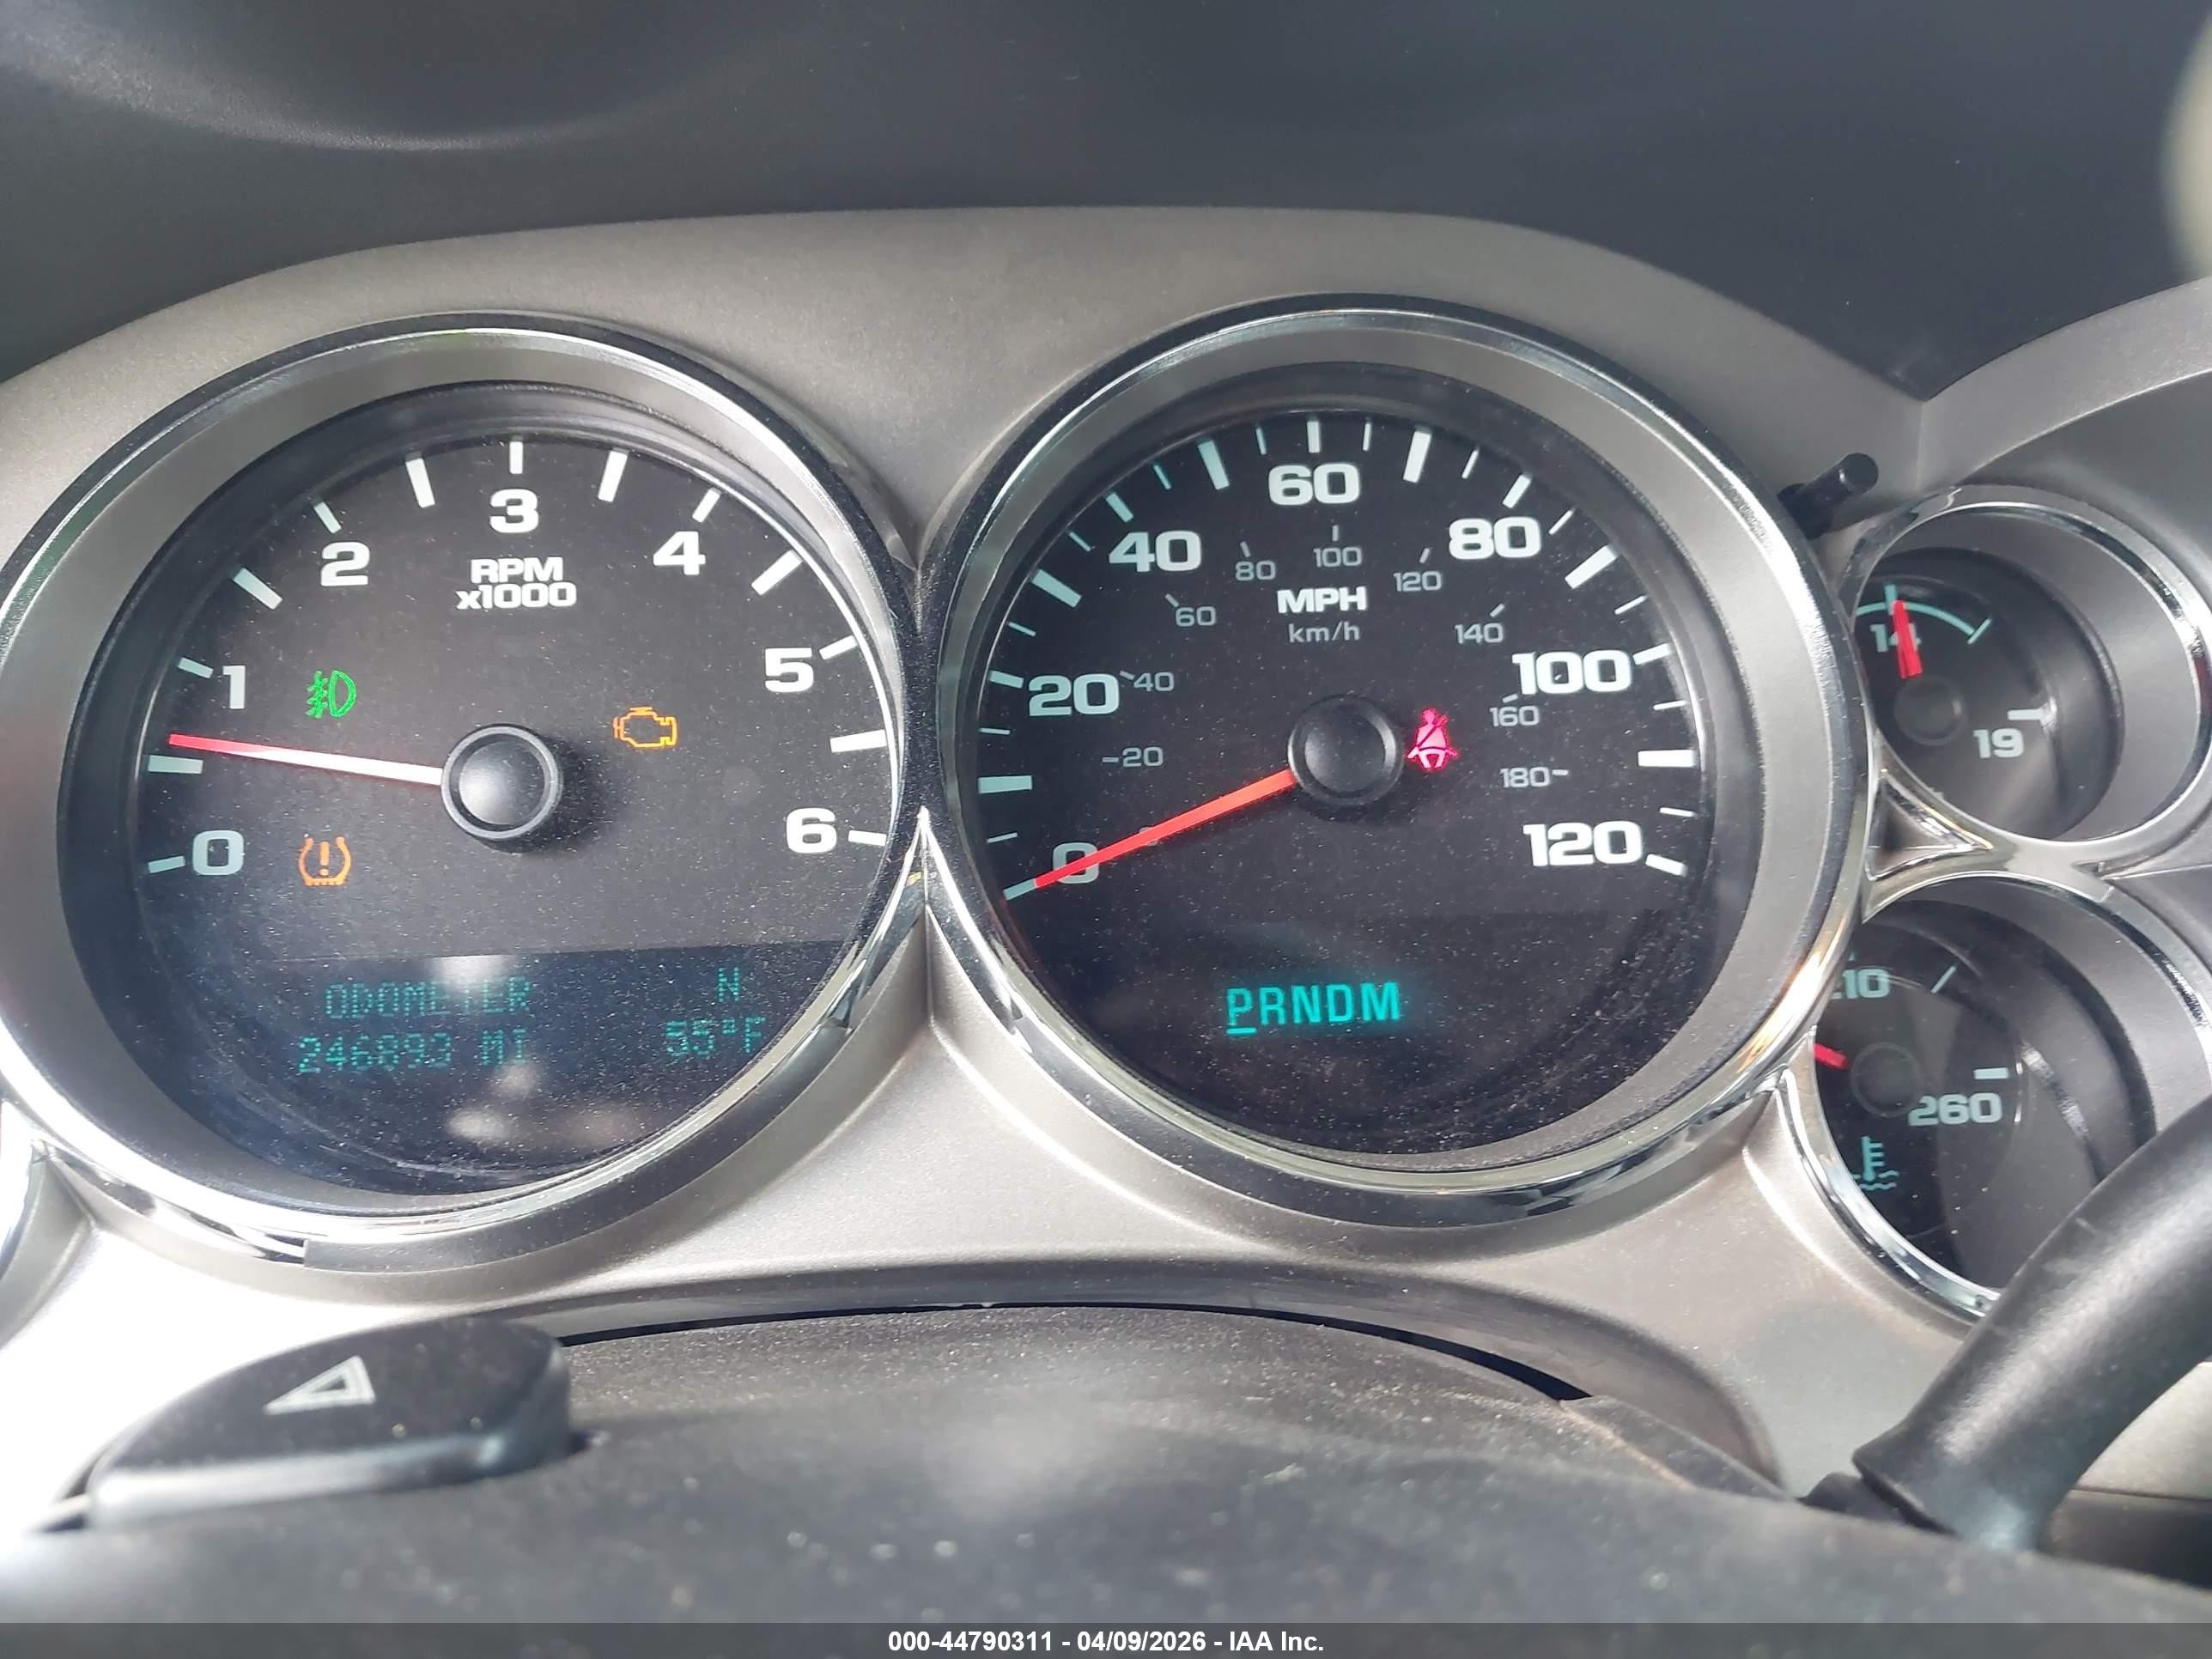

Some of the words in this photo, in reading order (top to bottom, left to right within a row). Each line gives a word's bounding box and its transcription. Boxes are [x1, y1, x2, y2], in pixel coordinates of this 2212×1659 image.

[1268, 463, 1359, 505] 60
[489, 489, 539, 533] 3
[653, 531, 706, 575] 4
[1109, 531, 1201, 572] 40
[1314, 547, 1362, 568] 100
[1449, 517, 1541, 560] 80
[320, 542, 370, 586] 2
[471, 556, 563, 584] RPM
[1235, 561, 1276, 580] 80
[1393, 571, 1442, 592] 120
[455, 582, 577, 610] x1000
[1277, 586, 1367, 613] MPH
[1176, 606, 1216, 626] 60
[1289, 623, 1360, 642] km/h
[1455, 623, 1504, 643] 140
[222, 665, 246, 709] 1
[764, 647, 813, 692] 5
[1133, 672, 1175, 692] 40
[1511, 650, 1632, 696] 100
[1029, 673, 1120, 716] 20
[1490, 705, 1540, 726] 160
[1122, 746, 1164, 767] 20
[1974, 728, 2024, 759] 19
[1500, 767, 1551, 787] 180
[786, 807, 837, 854] 6
[1522, 821, 1643, 866] 120
[192, 830, 244, 876] 0
[1052, 842, 1100, 884] 0
[325, 975, 531, 1019] ODOMETER
[1829, 968, 1890, 1000] 10
[1225, 981, 1401, 1026] PRNDM
[1908, 1092, 2002, 1127] 260
